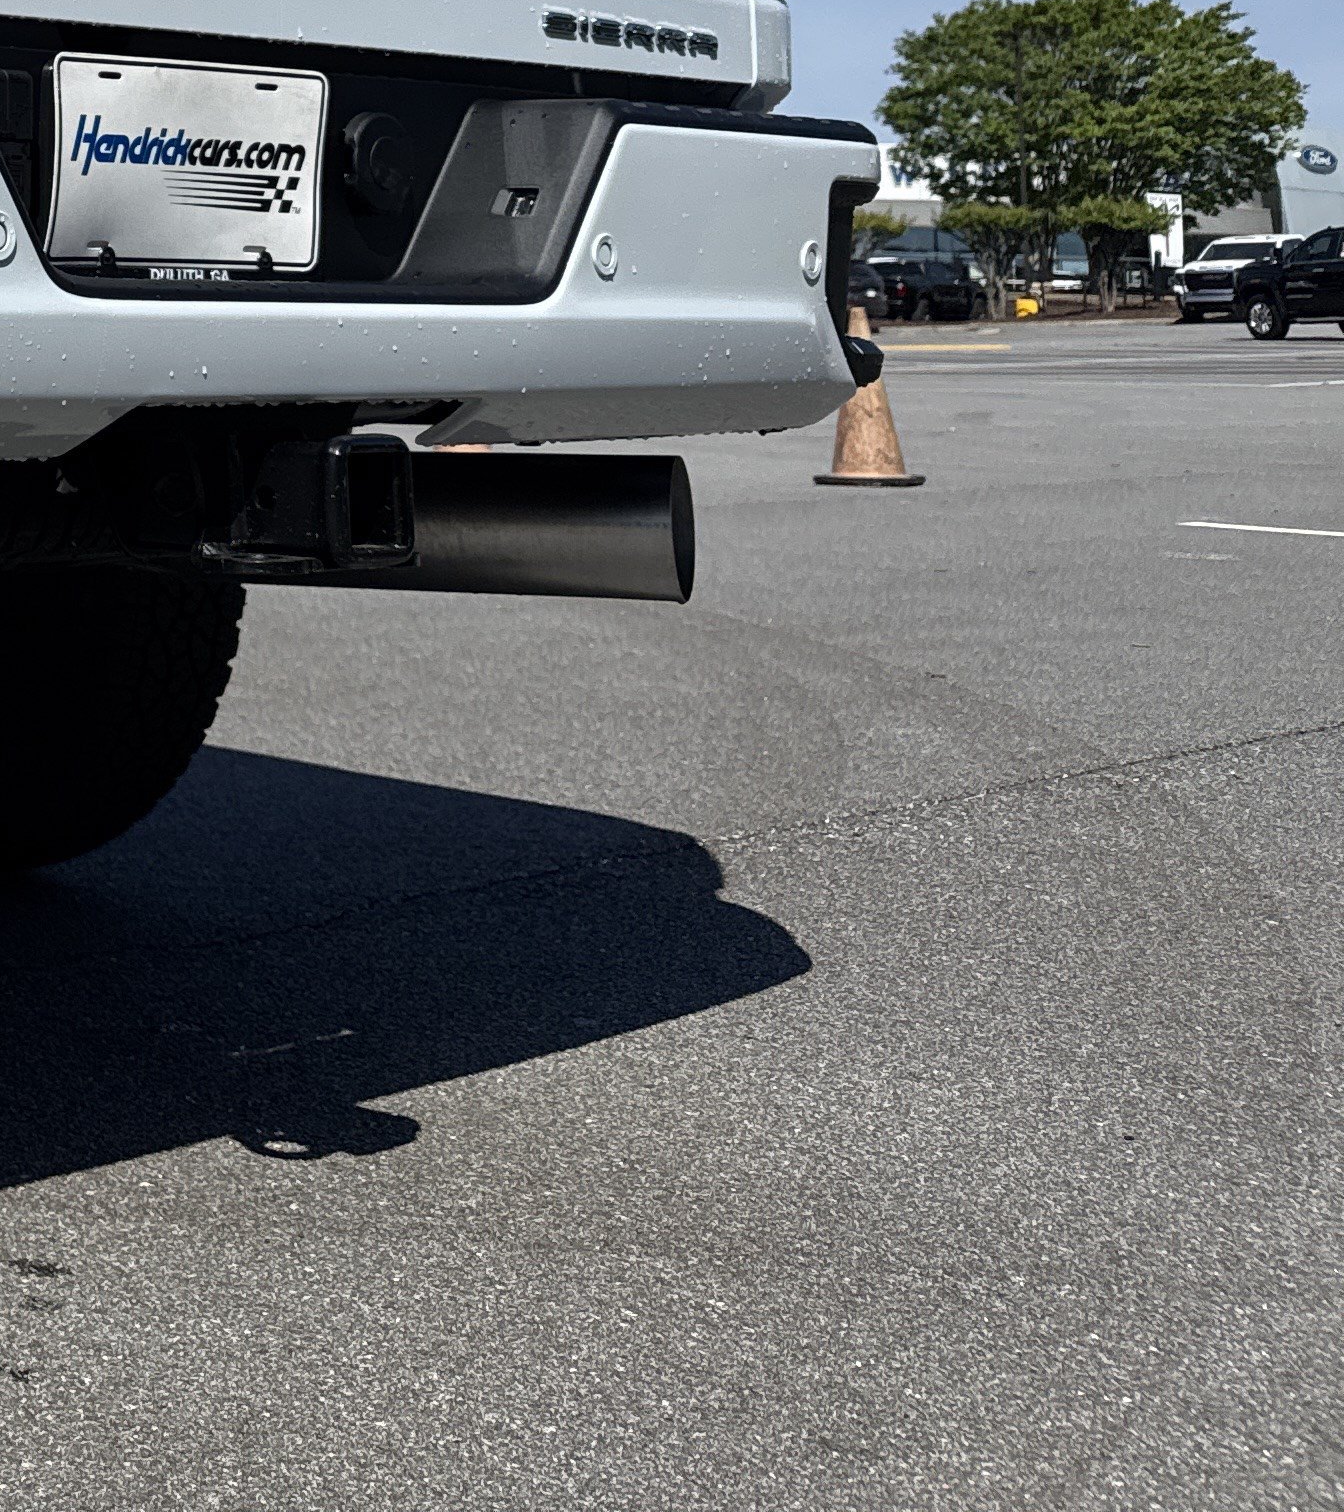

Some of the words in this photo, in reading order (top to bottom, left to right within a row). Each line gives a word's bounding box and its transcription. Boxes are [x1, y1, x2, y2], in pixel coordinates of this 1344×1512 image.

[541, 10, 719, 60] SIERRA
[70, 114, 306, 176] Hendrickcars.com
[209, 269, 230, 282] GA
